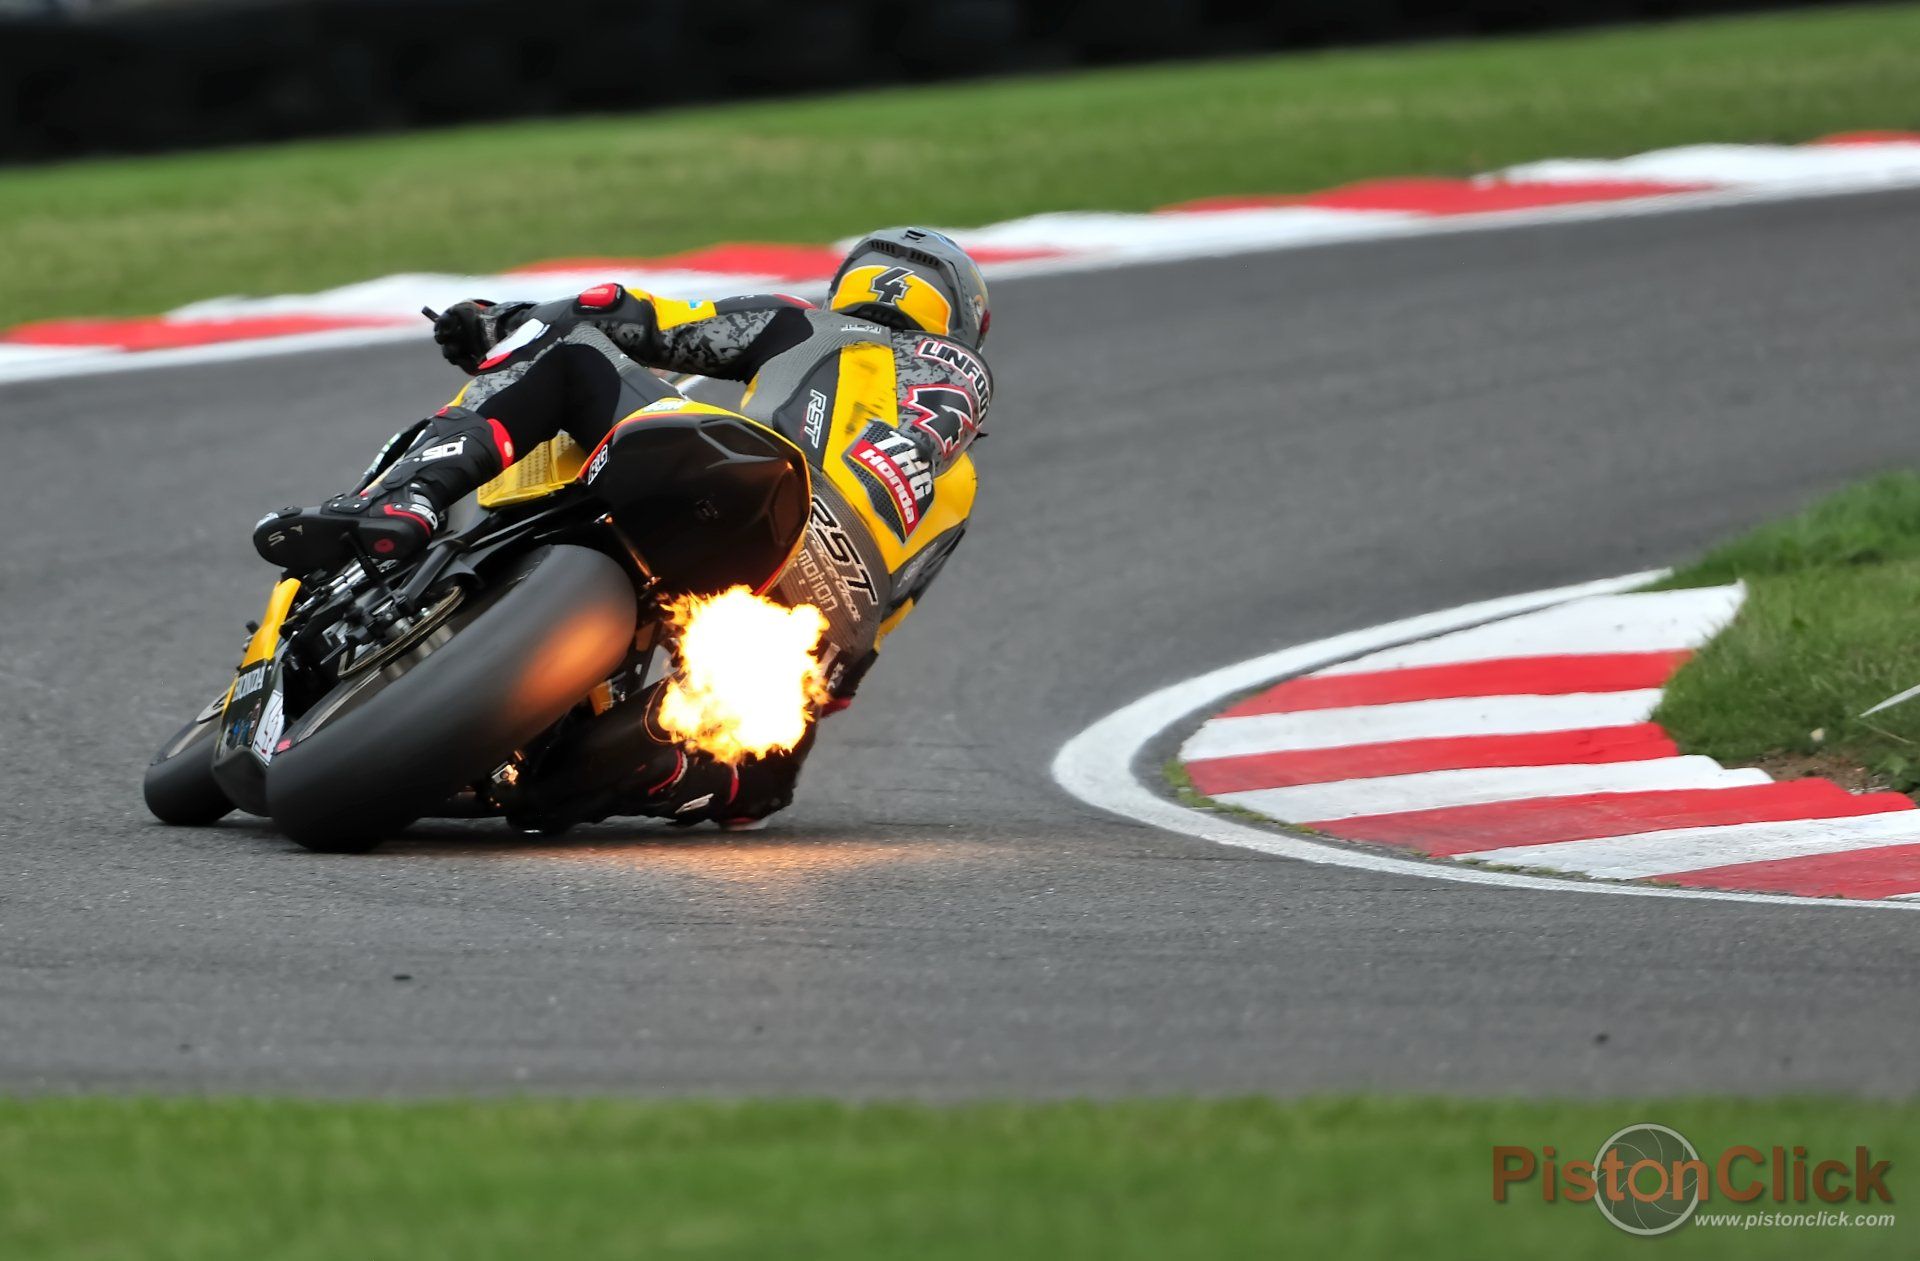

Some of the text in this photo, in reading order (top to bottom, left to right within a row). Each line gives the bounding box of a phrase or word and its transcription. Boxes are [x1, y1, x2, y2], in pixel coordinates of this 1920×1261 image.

[870, 266, 914, 305] 4
[804, 388, 827, 449] RST
[859, 448, 915, 524] Honda
